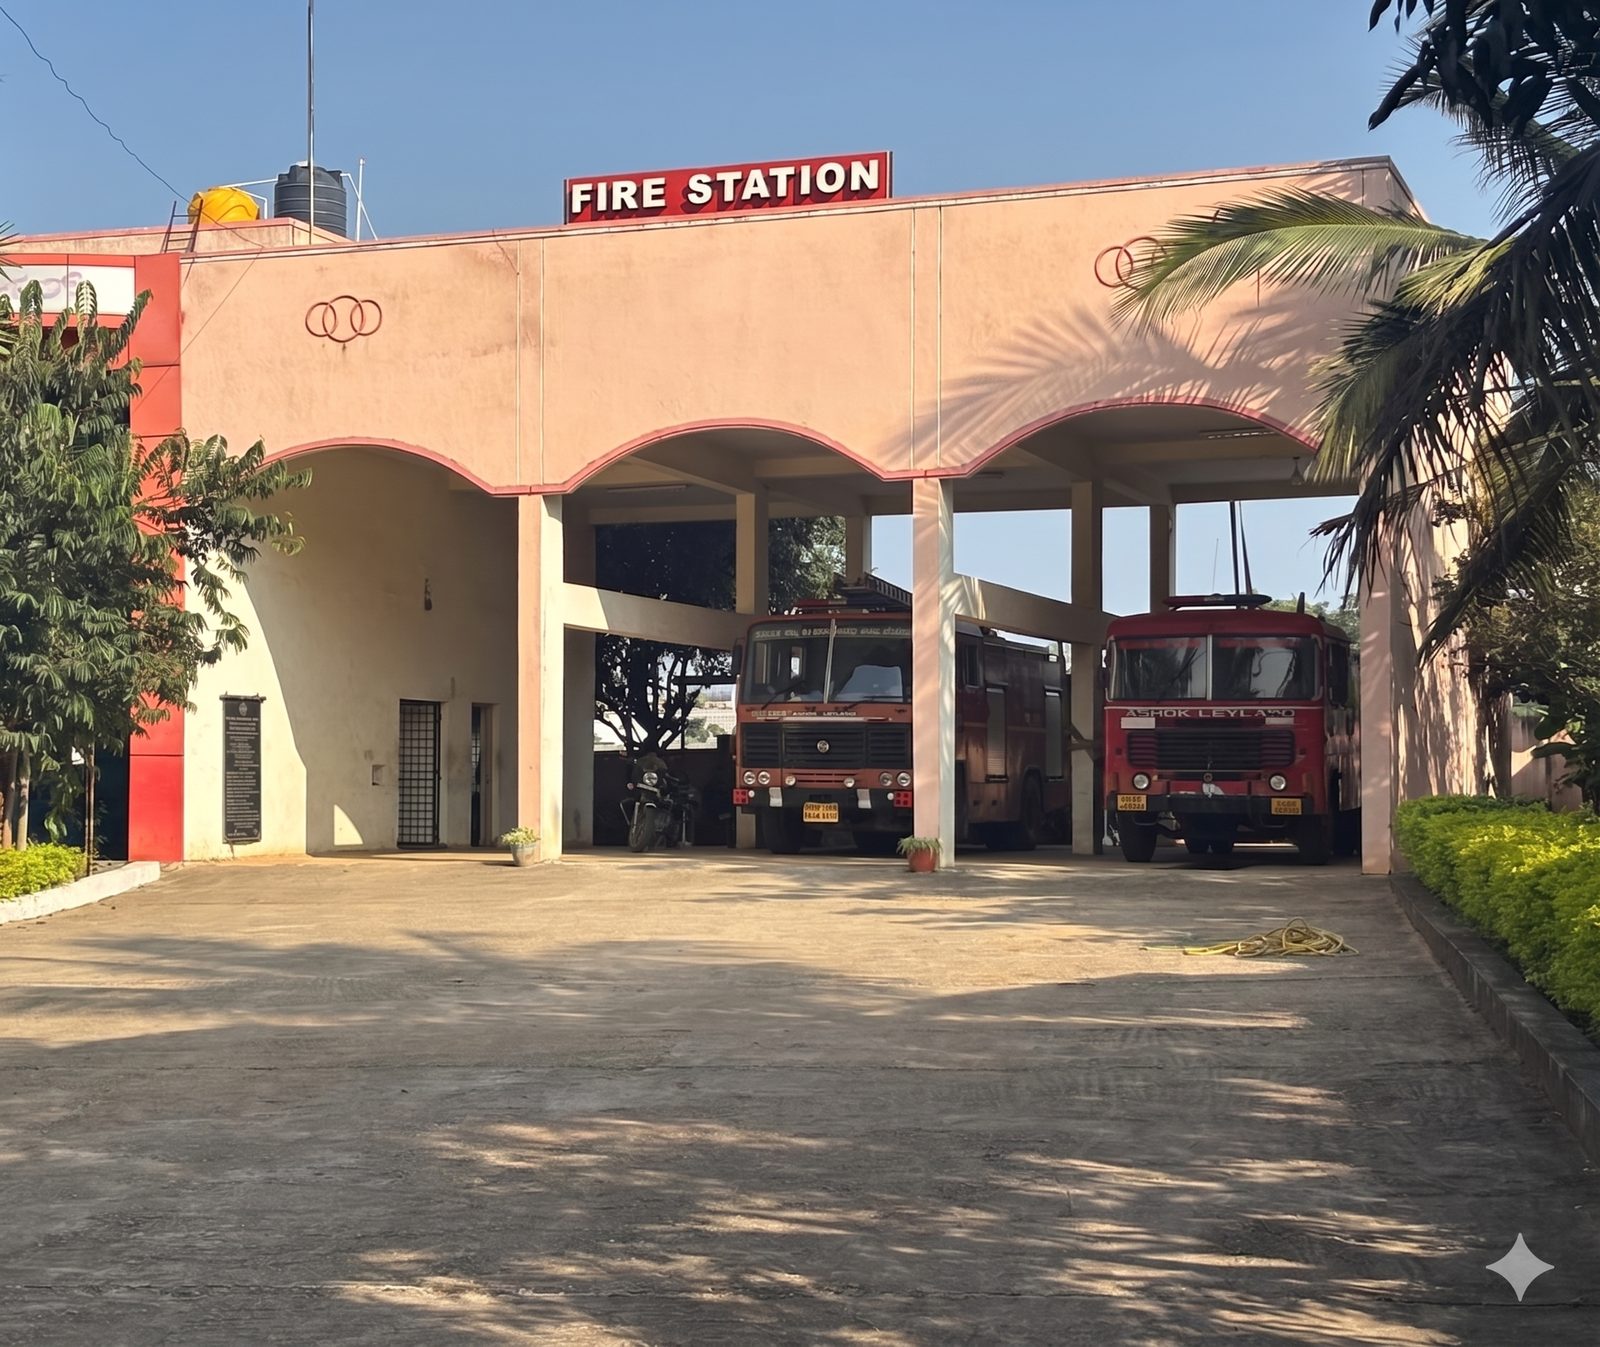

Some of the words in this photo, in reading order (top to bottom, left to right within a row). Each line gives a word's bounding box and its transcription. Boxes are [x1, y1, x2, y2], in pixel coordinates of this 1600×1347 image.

[571, 177, 666, 214] FIRE
[687, 159, 879, 205] STATION
[1126, 709, 1191, 717] ASHOK
